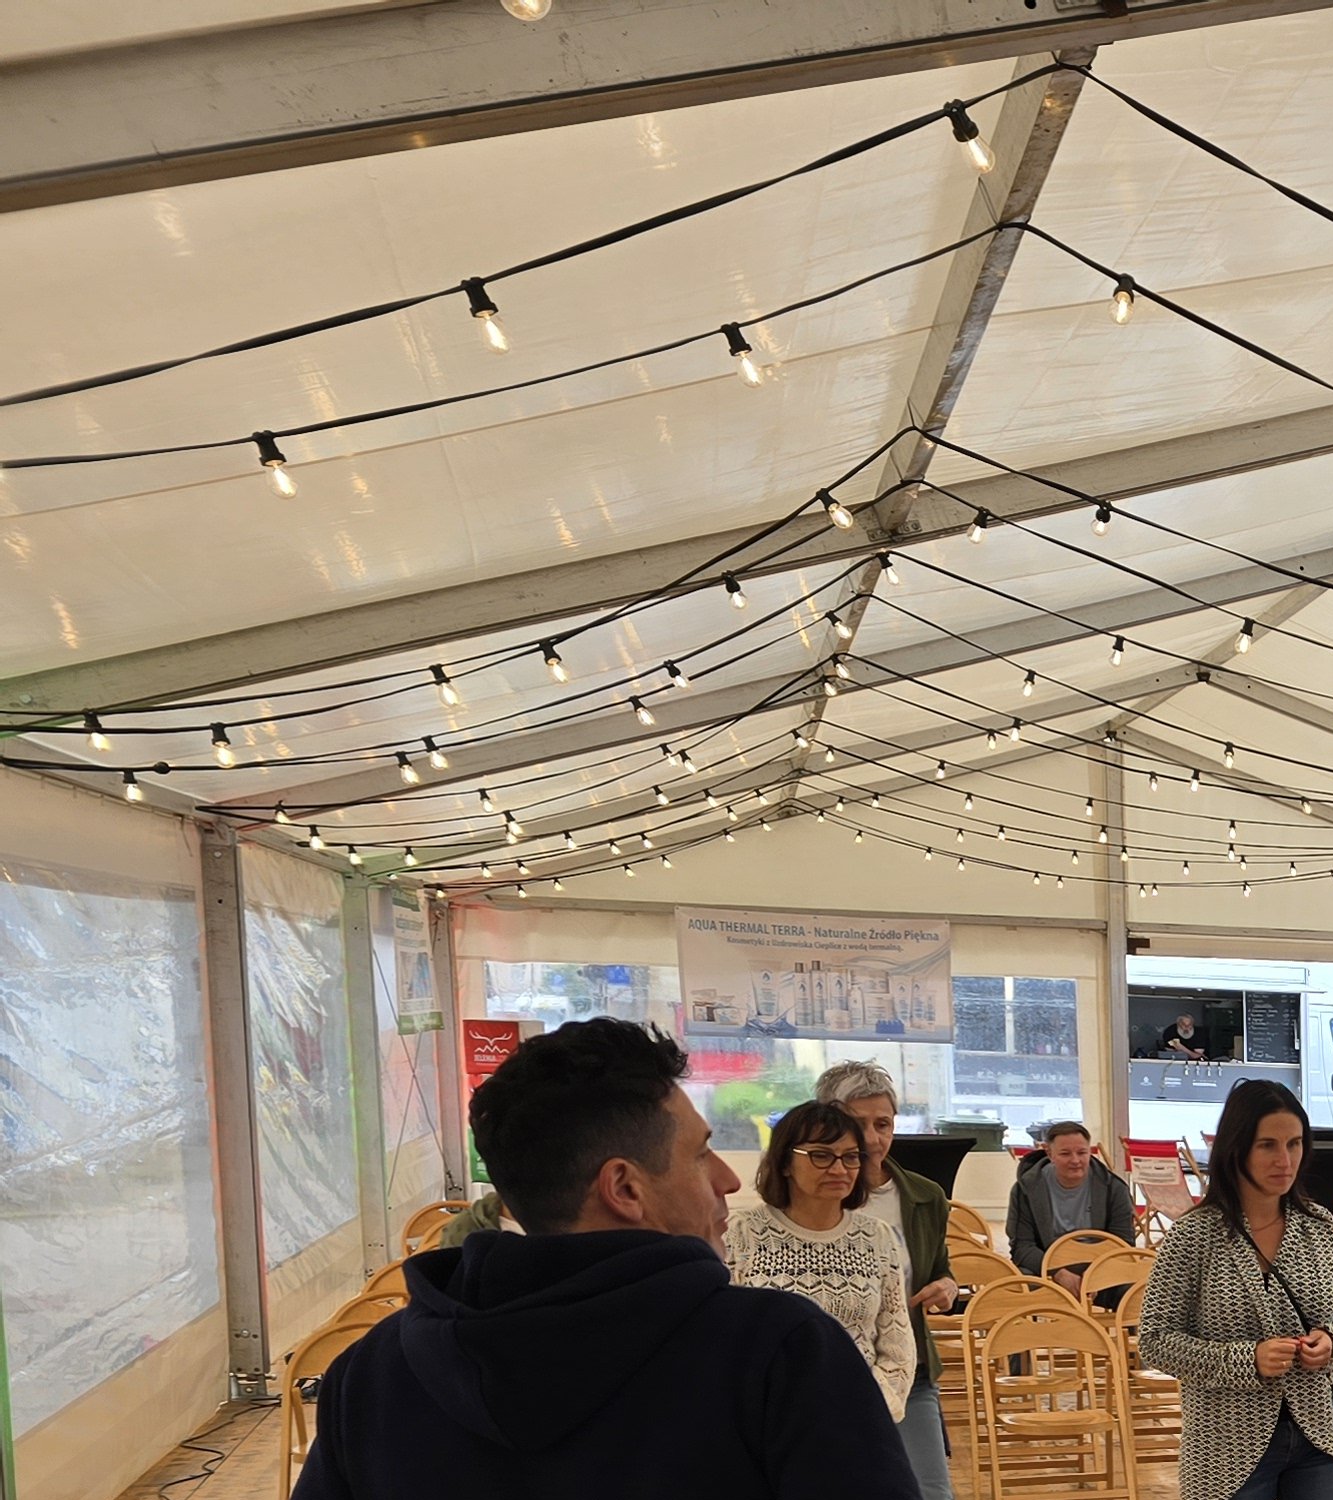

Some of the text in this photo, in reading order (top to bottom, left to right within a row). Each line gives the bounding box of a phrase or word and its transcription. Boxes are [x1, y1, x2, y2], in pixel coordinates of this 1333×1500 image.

[688, 919, 717, 931] AQUA
[719, 921, 769, 935] THERMAL
[771, 924, 806, 937] TERRA
[814, 927, 866, 940] Naturalne
[869, 928, 902, 941] Źródło
[904, 931, 940, 943] Piękna
